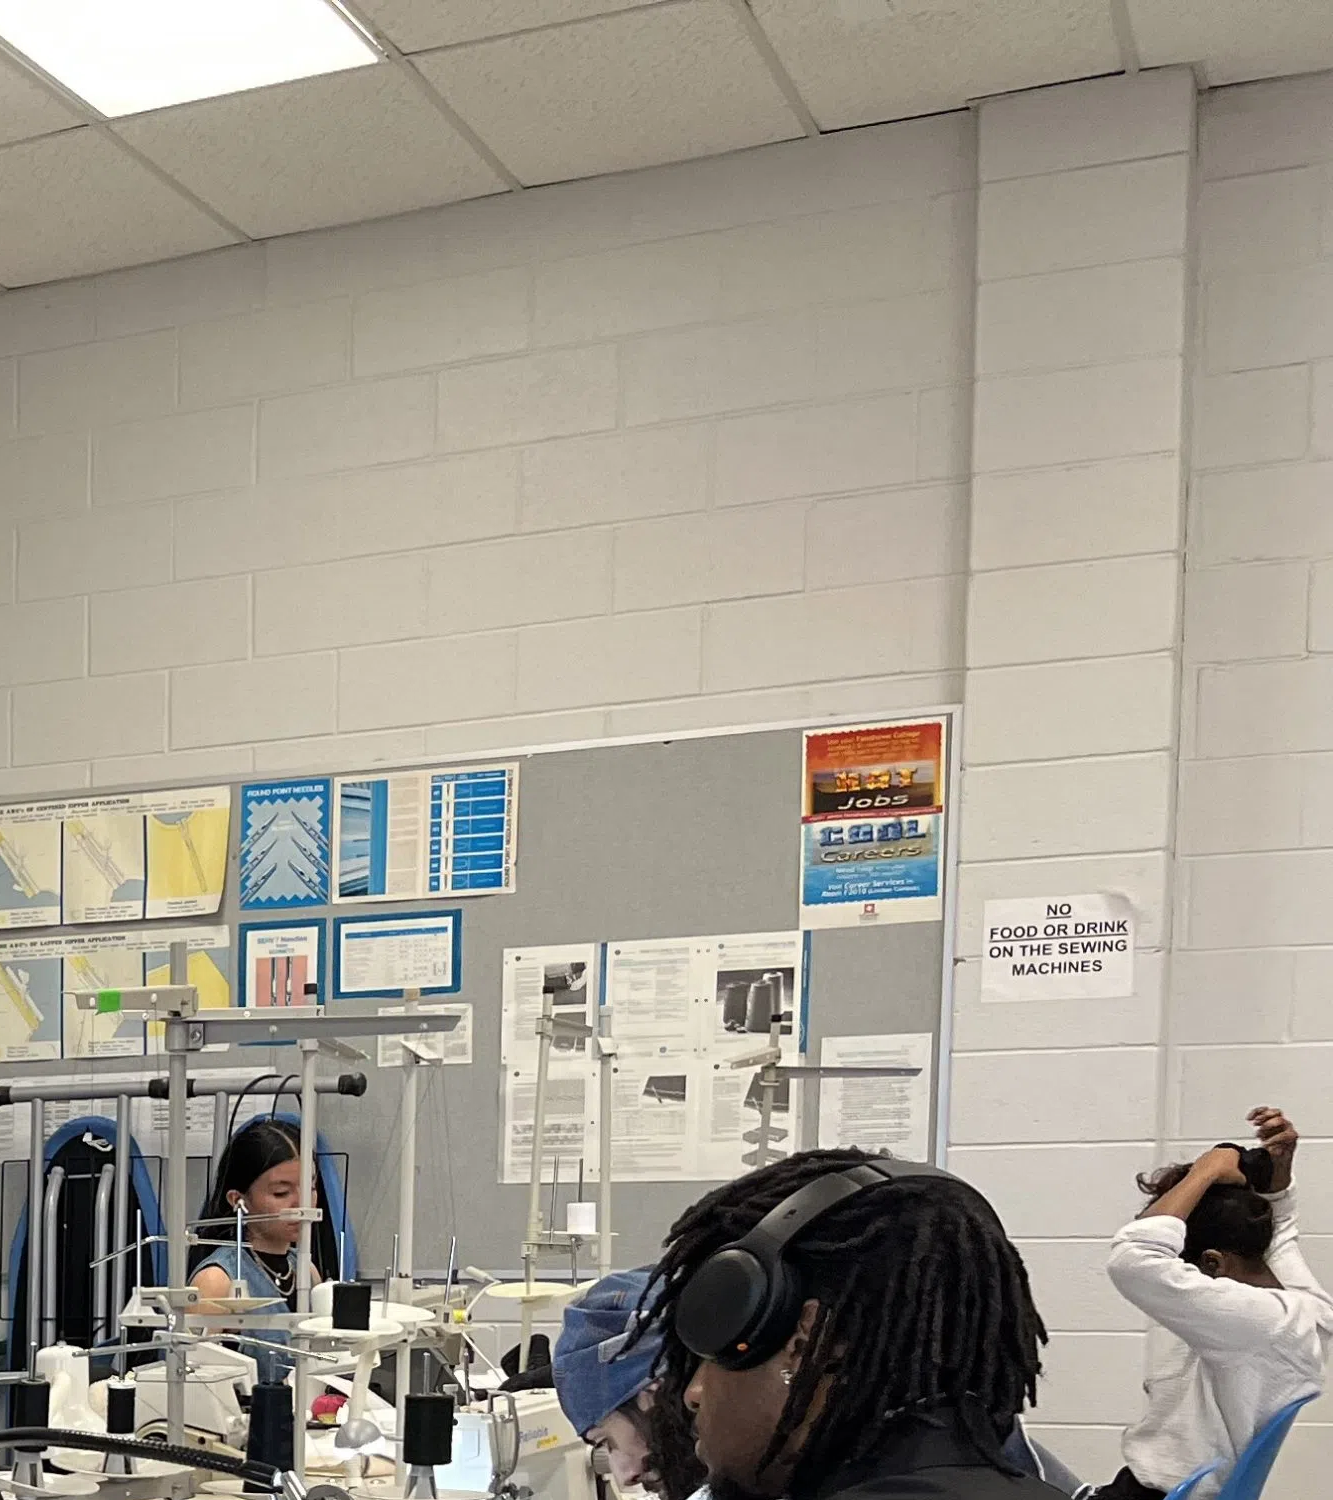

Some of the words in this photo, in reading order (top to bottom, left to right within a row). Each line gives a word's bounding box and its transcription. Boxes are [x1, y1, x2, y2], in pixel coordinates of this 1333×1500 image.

[820, 846, 923, 863] Careers
[1046, 903, 1072, 917] NO
[989, 925, 1038, 941] FOOD
[1043, 923, 1068, 937] OR
[1074, 920, 1129, 935] DRINK
[989, 945, 1014, 959] ON
[1019, 943, 1053, 957] THE
[1058, 940, 1128, 955] SEWING
[1012, 960, 1103, 976] MACHINES
